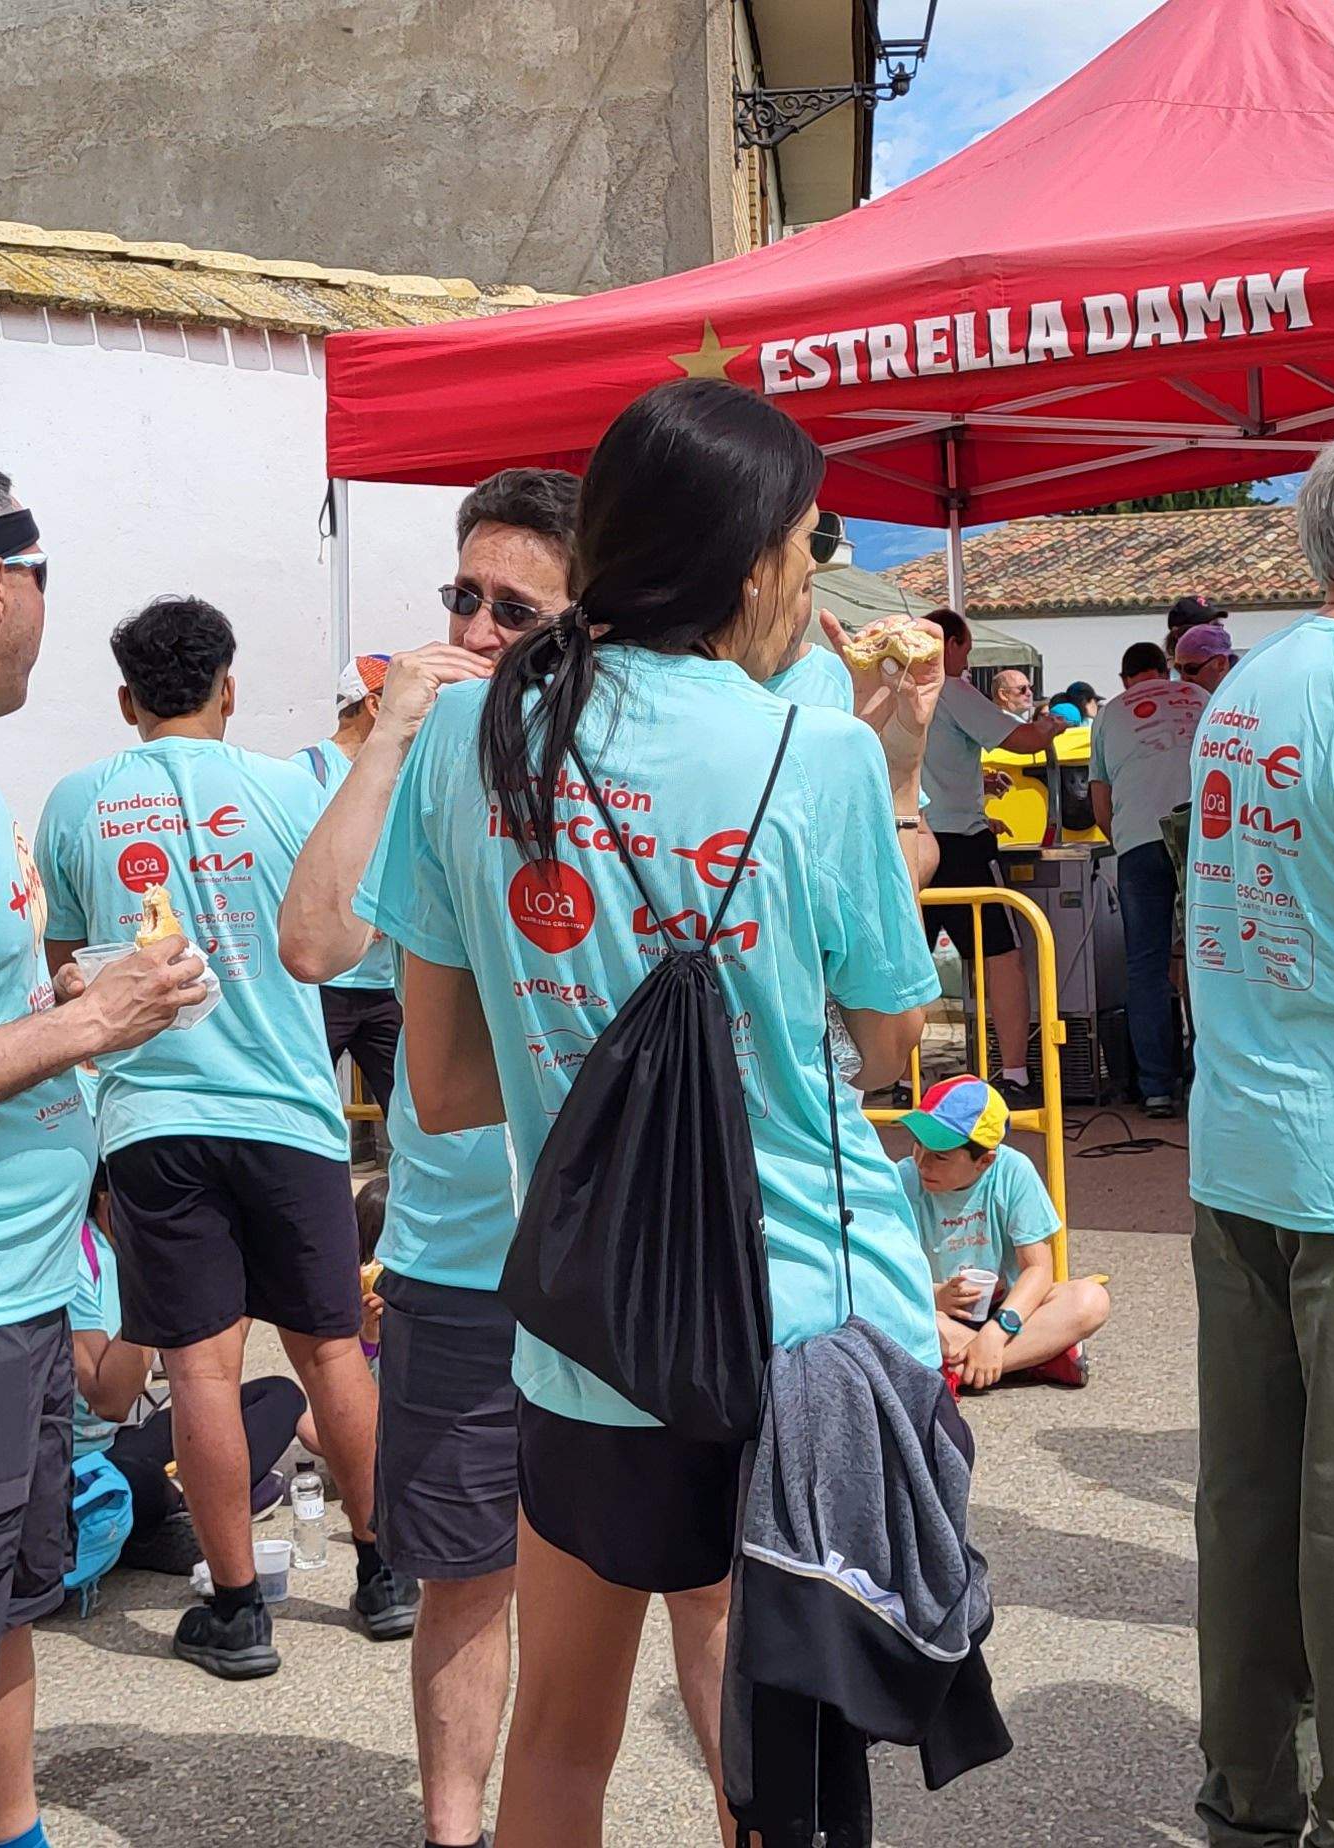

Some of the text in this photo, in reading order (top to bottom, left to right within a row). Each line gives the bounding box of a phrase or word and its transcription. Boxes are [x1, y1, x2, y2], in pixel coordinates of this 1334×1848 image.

[758, 267, 1313, 395] ESTRELLA DAMM
[513, 976, 587, 1001] avanza
